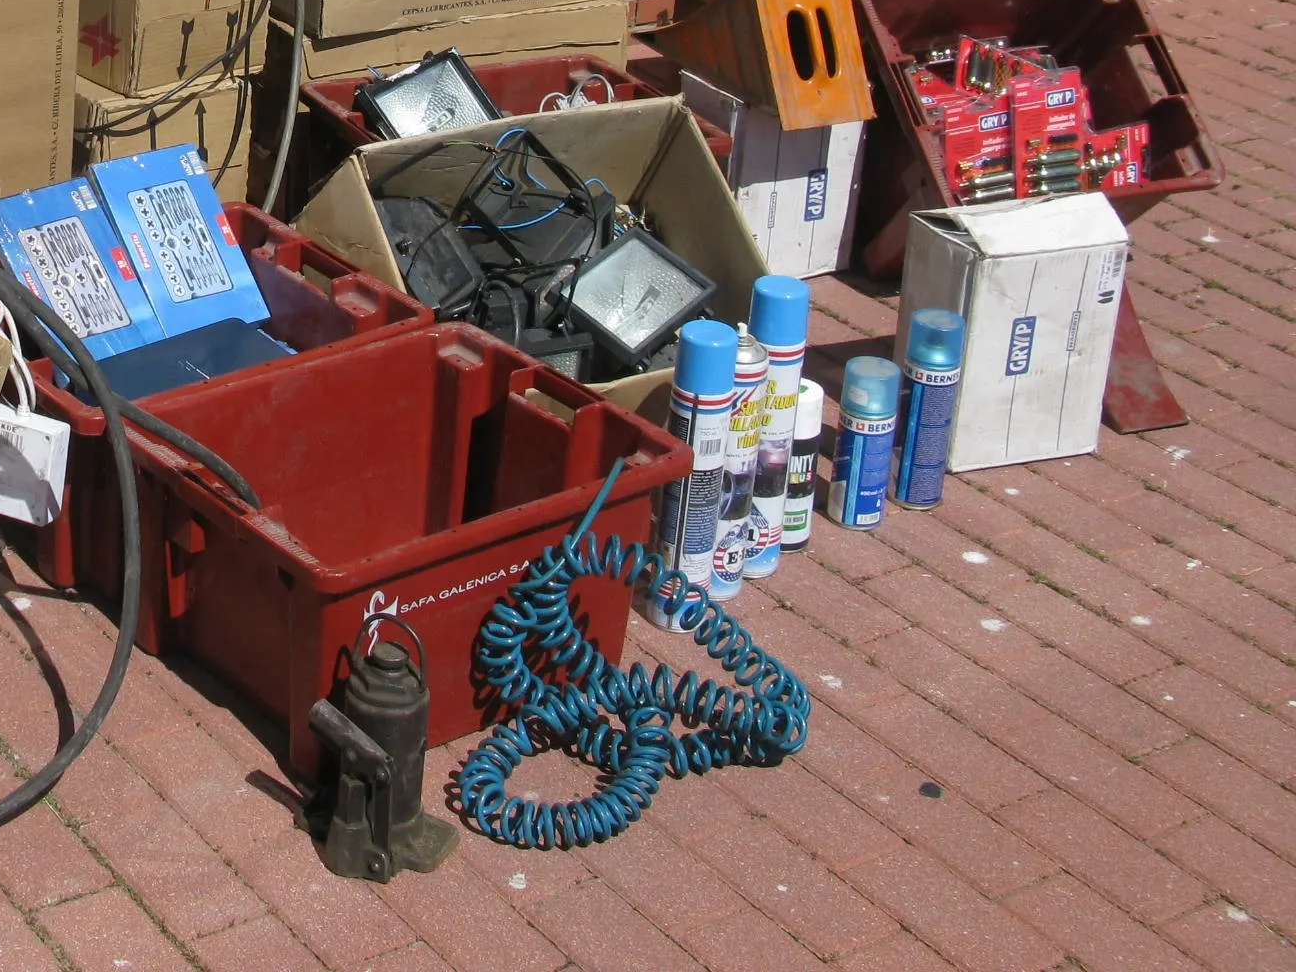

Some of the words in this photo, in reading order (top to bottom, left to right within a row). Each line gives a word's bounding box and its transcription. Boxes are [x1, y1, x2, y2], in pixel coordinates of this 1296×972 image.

[402, 7, 425, 16] CEPSA
[53, 85, 61, 118] RIBERA
[400, 595, 436, 614] SAFA
[438, 568, 507, 600] GALENICA
